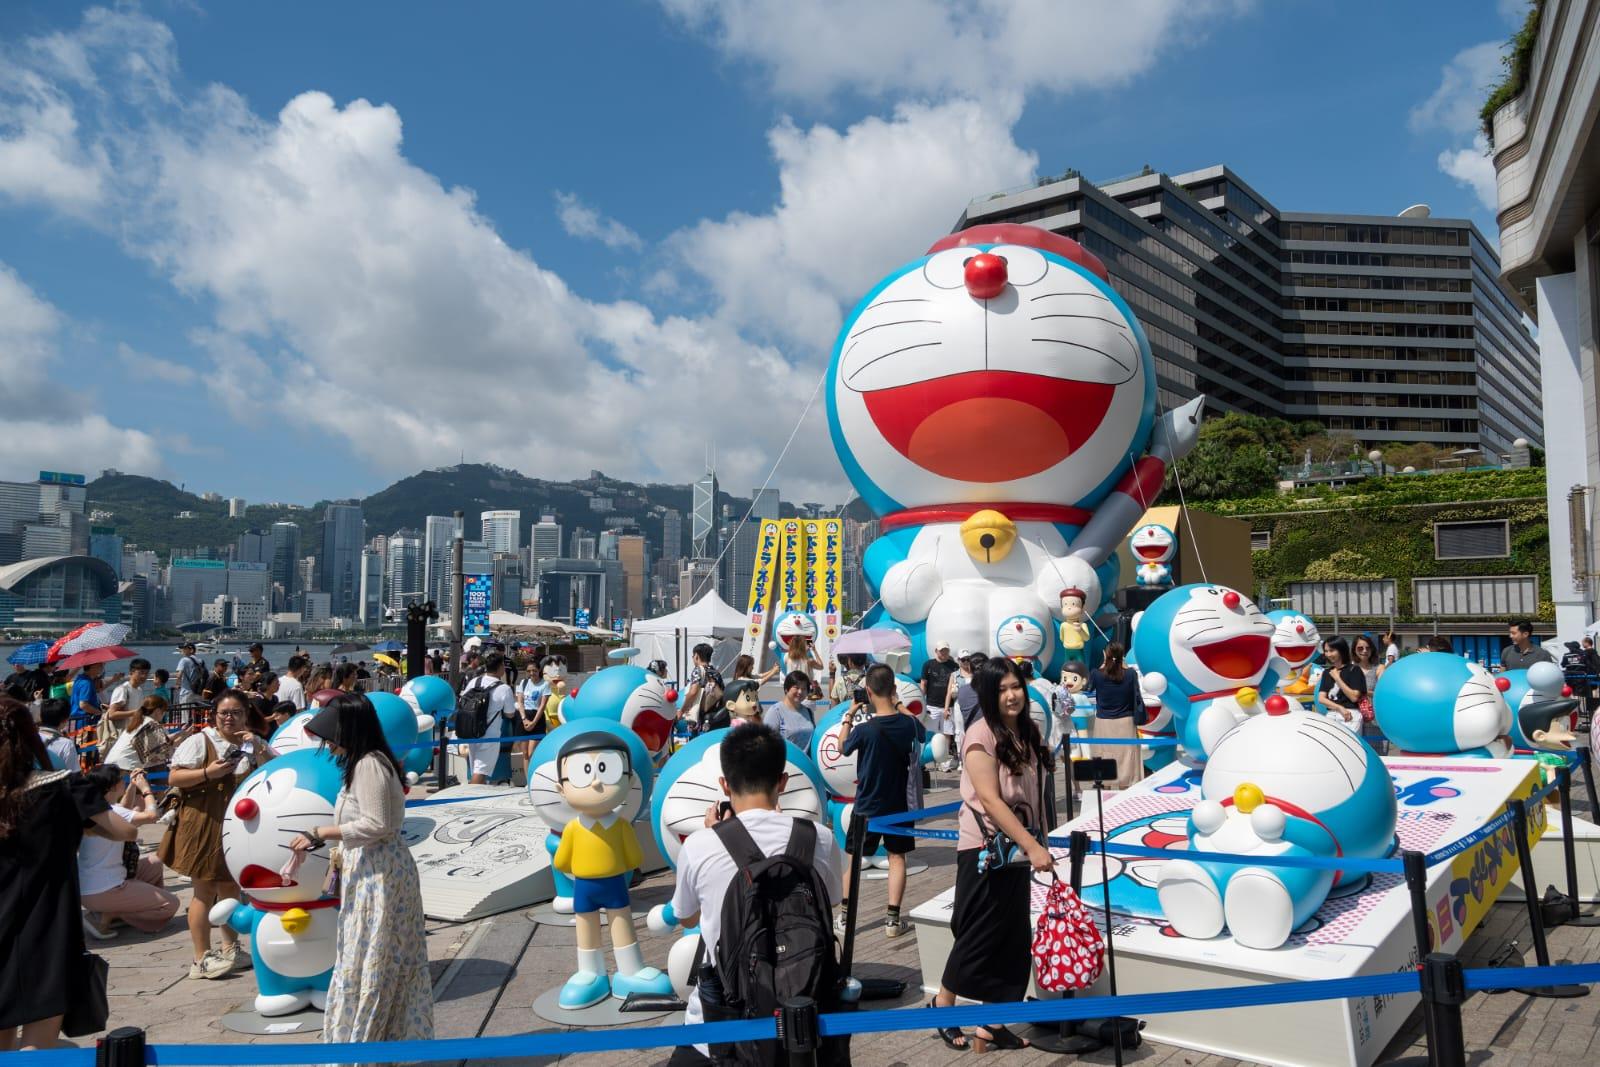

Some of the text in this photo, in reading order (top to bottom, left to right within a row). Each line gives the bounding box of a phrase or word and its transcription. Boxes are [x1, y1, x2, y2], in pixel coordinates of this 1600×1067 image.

[752, 535, 775, 614] ドラえもん
[805, 535, 818, 614] ドラえもん
[825, 535, 838, 614] ドラえもん
